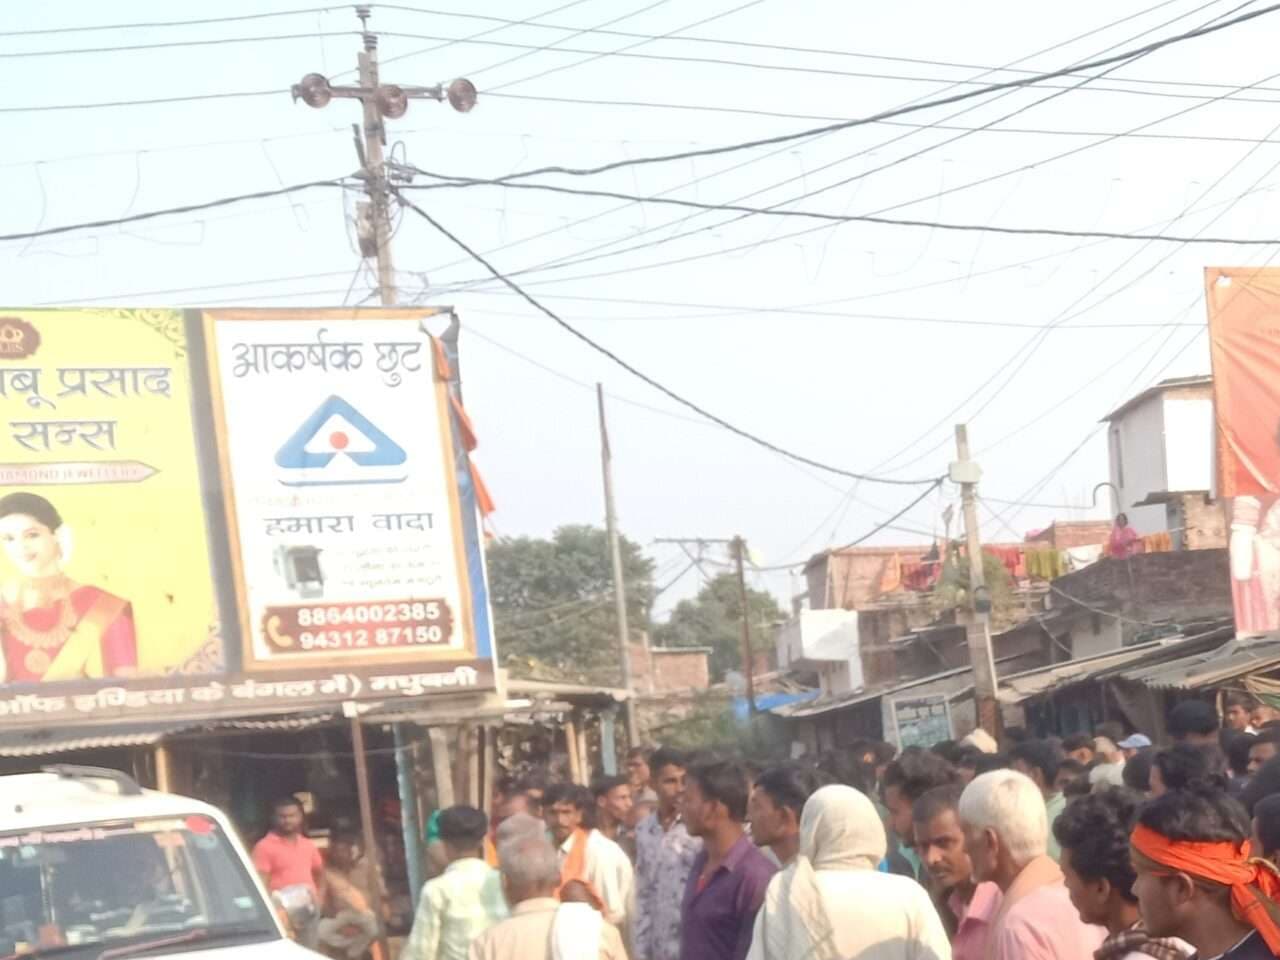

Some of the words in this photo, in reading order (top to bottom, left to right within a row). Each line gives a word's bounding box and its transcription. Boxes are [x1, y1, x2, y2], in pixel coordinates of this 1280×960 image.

[232, 328, 363, 377] आकर्षक
[0, 368, 57, 410] ाबू
[56, 367, 172, 399] प्रसाद
[10, 421, 118, 452] सन्स
[263, 515, 355, 536] हमारा
[371, 512, 434, 531] वादा
